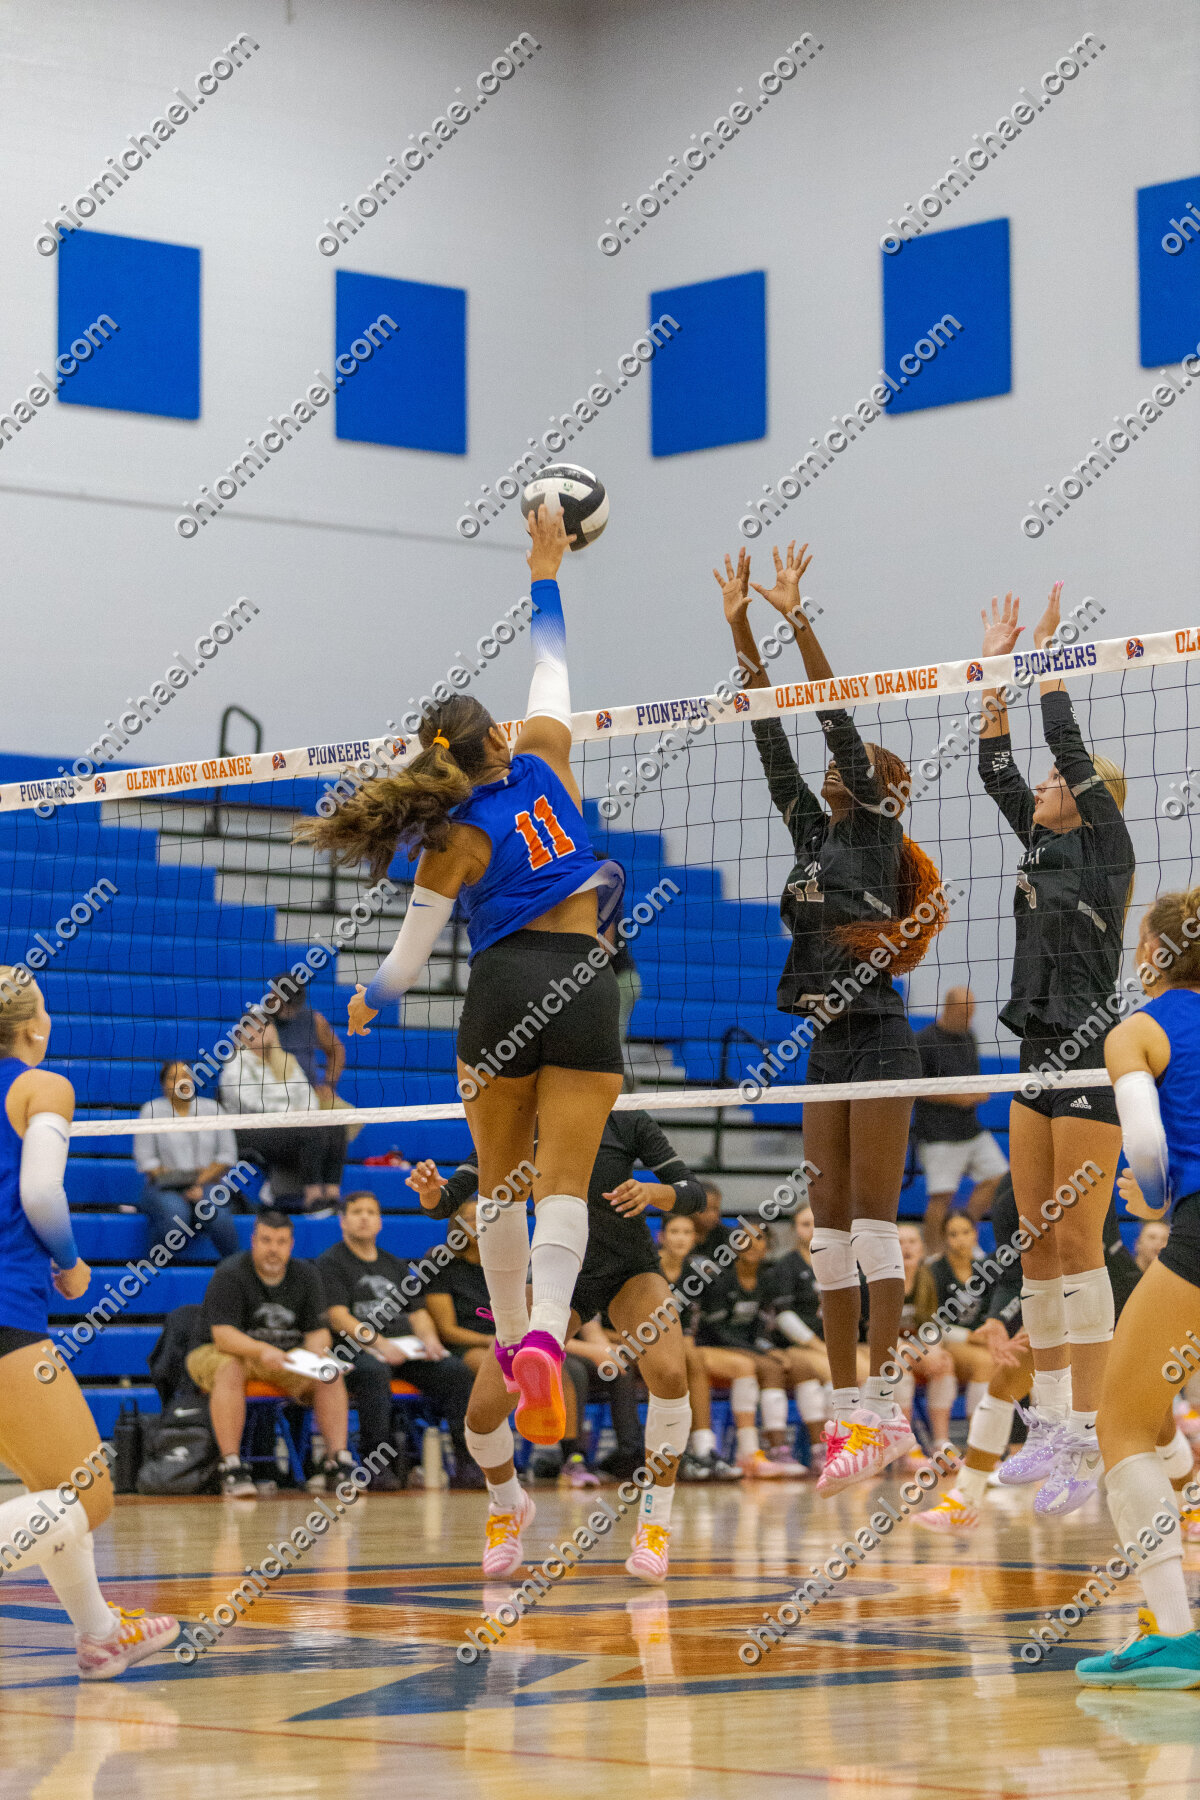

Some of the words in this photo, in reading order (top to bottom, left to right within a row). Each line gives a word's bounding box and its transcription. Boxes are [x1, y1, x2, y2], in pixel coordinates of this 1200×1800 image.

[1014, 644, 1097, 676] PIONEERS
[775, 676, 870, 709] OLENTANGY
[875, 667, 938, 695] ORANGE
[636, 698, 708, 726] PIONEERS
[307, 741, 371, 766] PIONEERS
[126, 763, 199, 791] OLENTANGY
[202, 756, 253, 780] ORANGE
[19, 780, 75, 802] PIONEERS
[515, 795, 576, 871] 11
